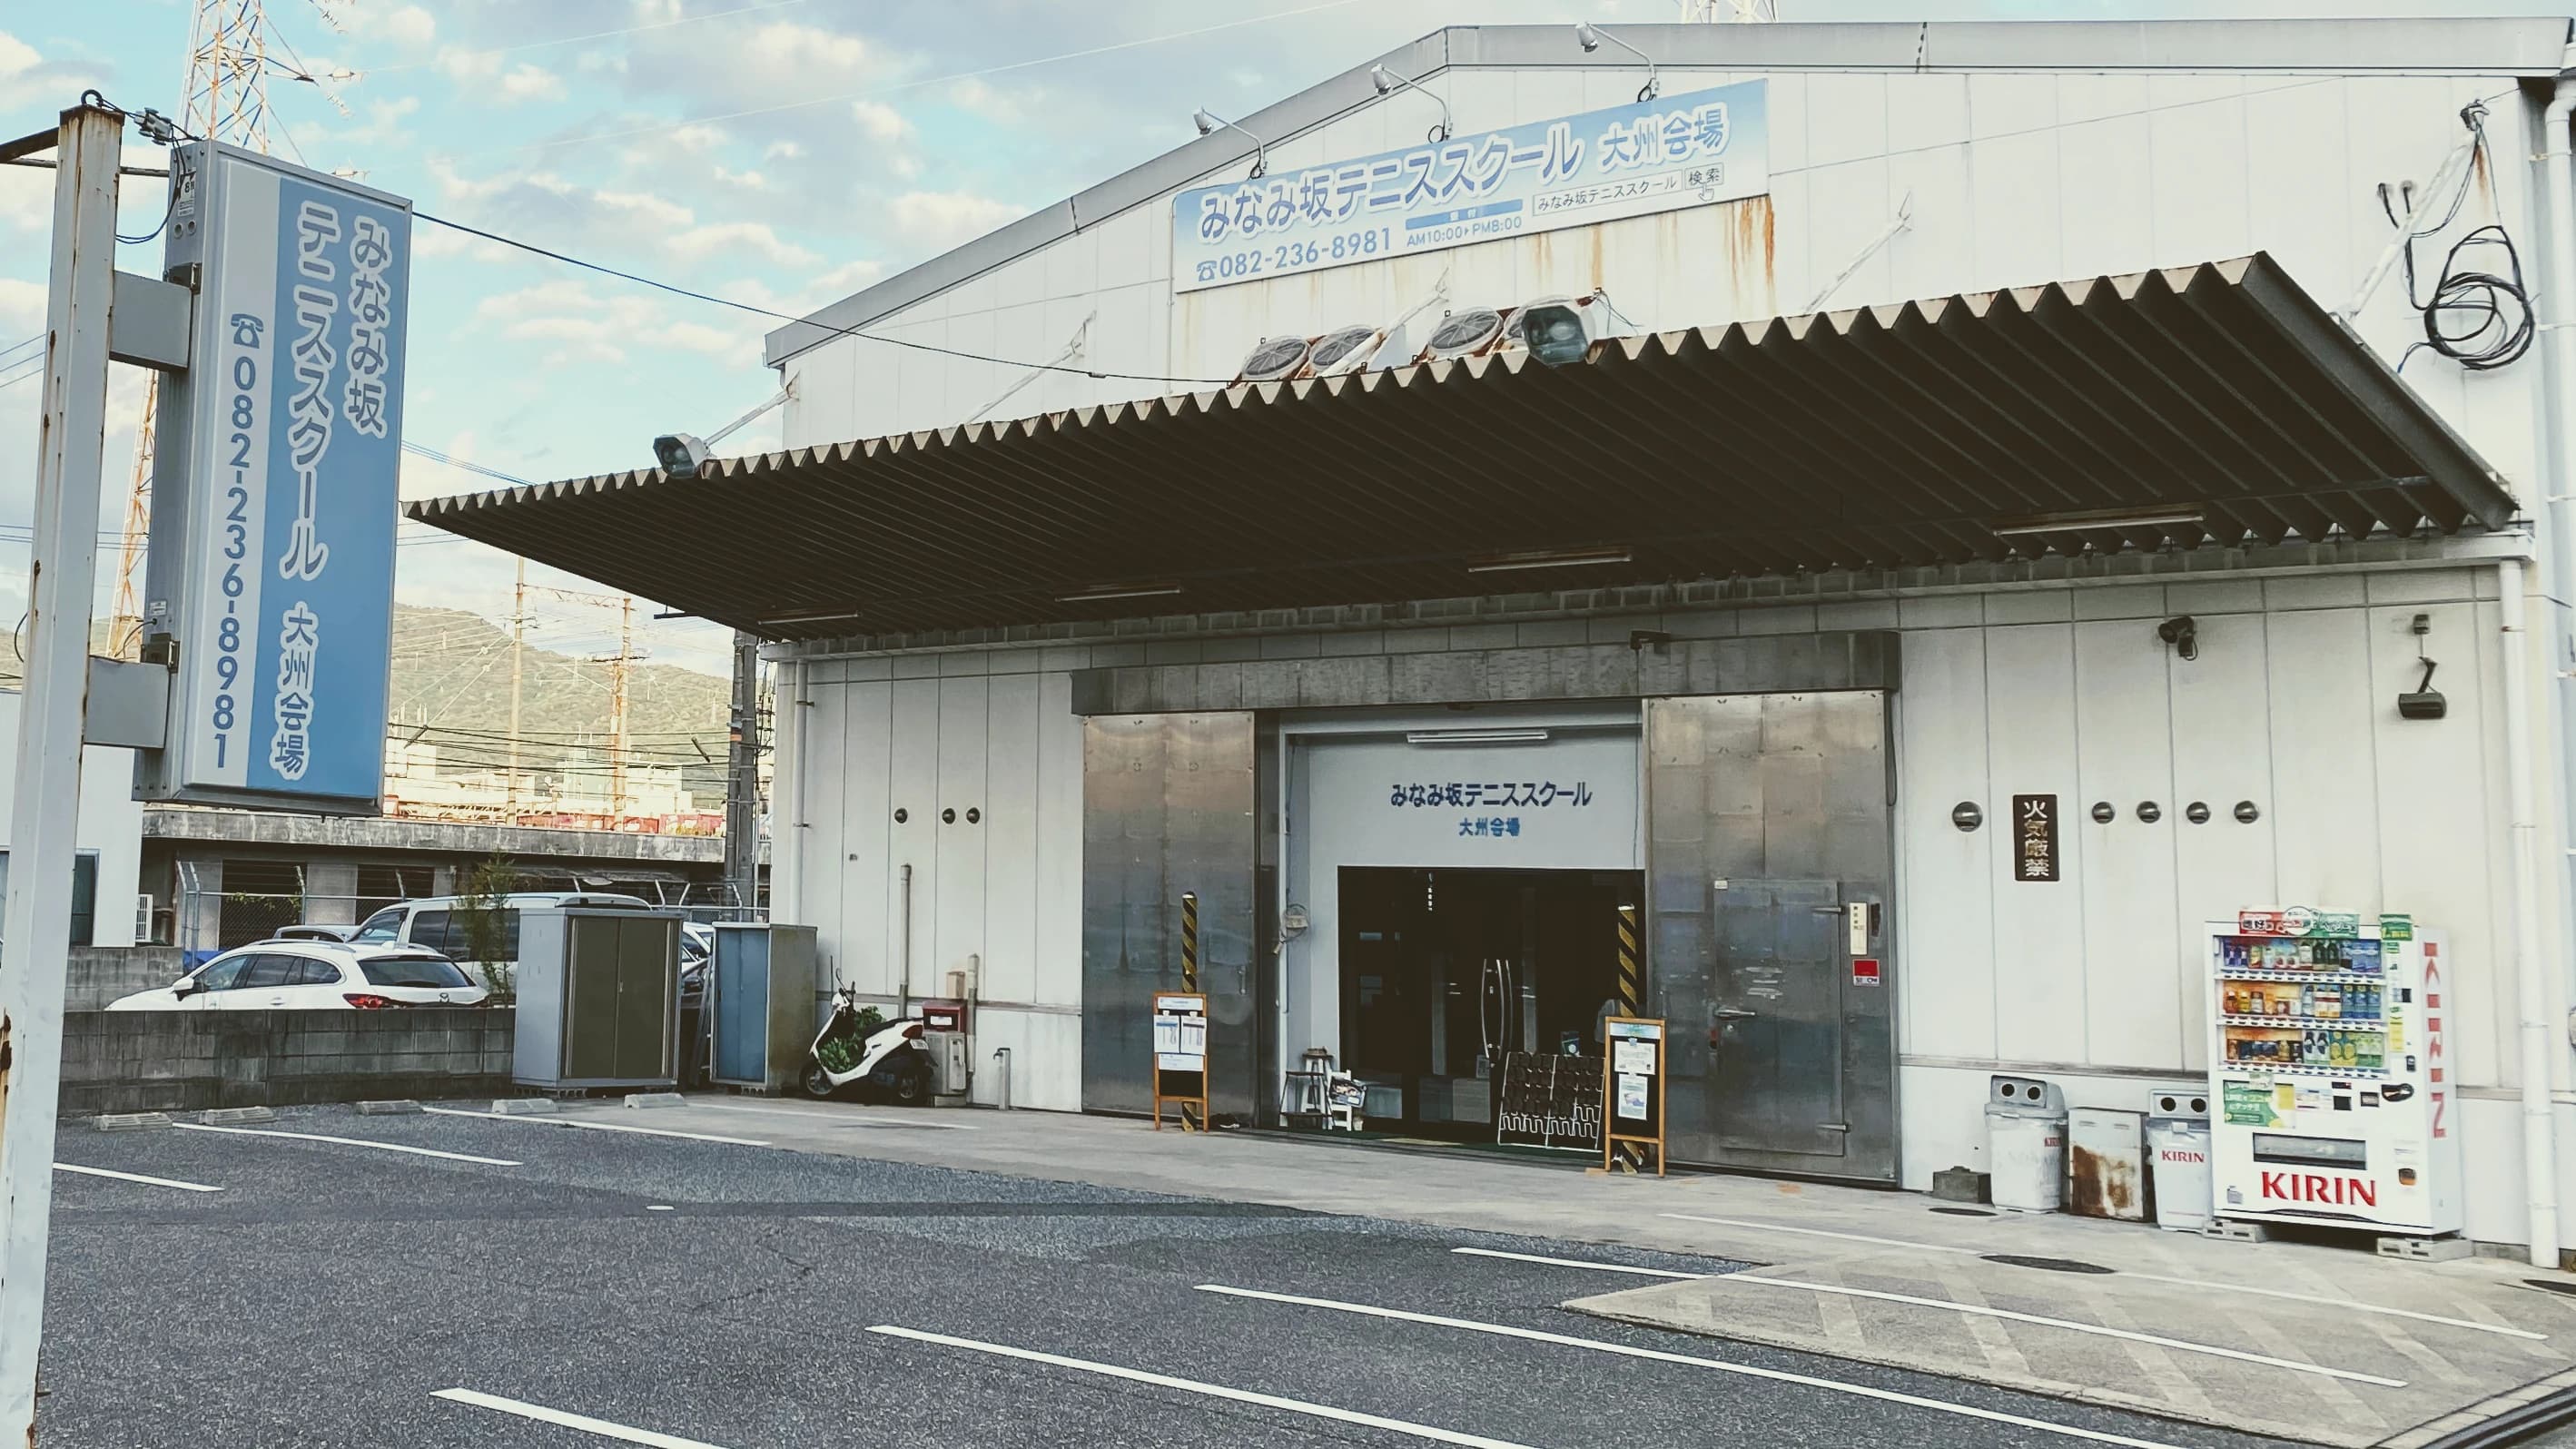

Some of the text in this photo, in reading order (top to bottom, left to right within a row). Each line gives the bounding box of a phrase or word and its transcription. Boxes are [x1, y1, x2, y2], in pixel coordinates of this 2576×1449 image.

[1200, 104, 1729, 242] みなみ坂テニススクール 大州会場
[1538, 167, 1720, 211] みなみ坂テニススクール 検索
[1219, 227, 1391, 278] 082-236-8981
[345, 217, 390, 438] みなみ坂
[271, 201, 339, 779] テニススクール 大州会場
[213, 357, 256, 769] 082-236-8981
[1391, 782, 1593, 807] みなみ坂テニススクール
[1458, 817, 1520, 837] 大州会場
[2161, 1149, 2205, 1163] KIRIN
[2261, 1171, 2377, 1207] KIRIN
